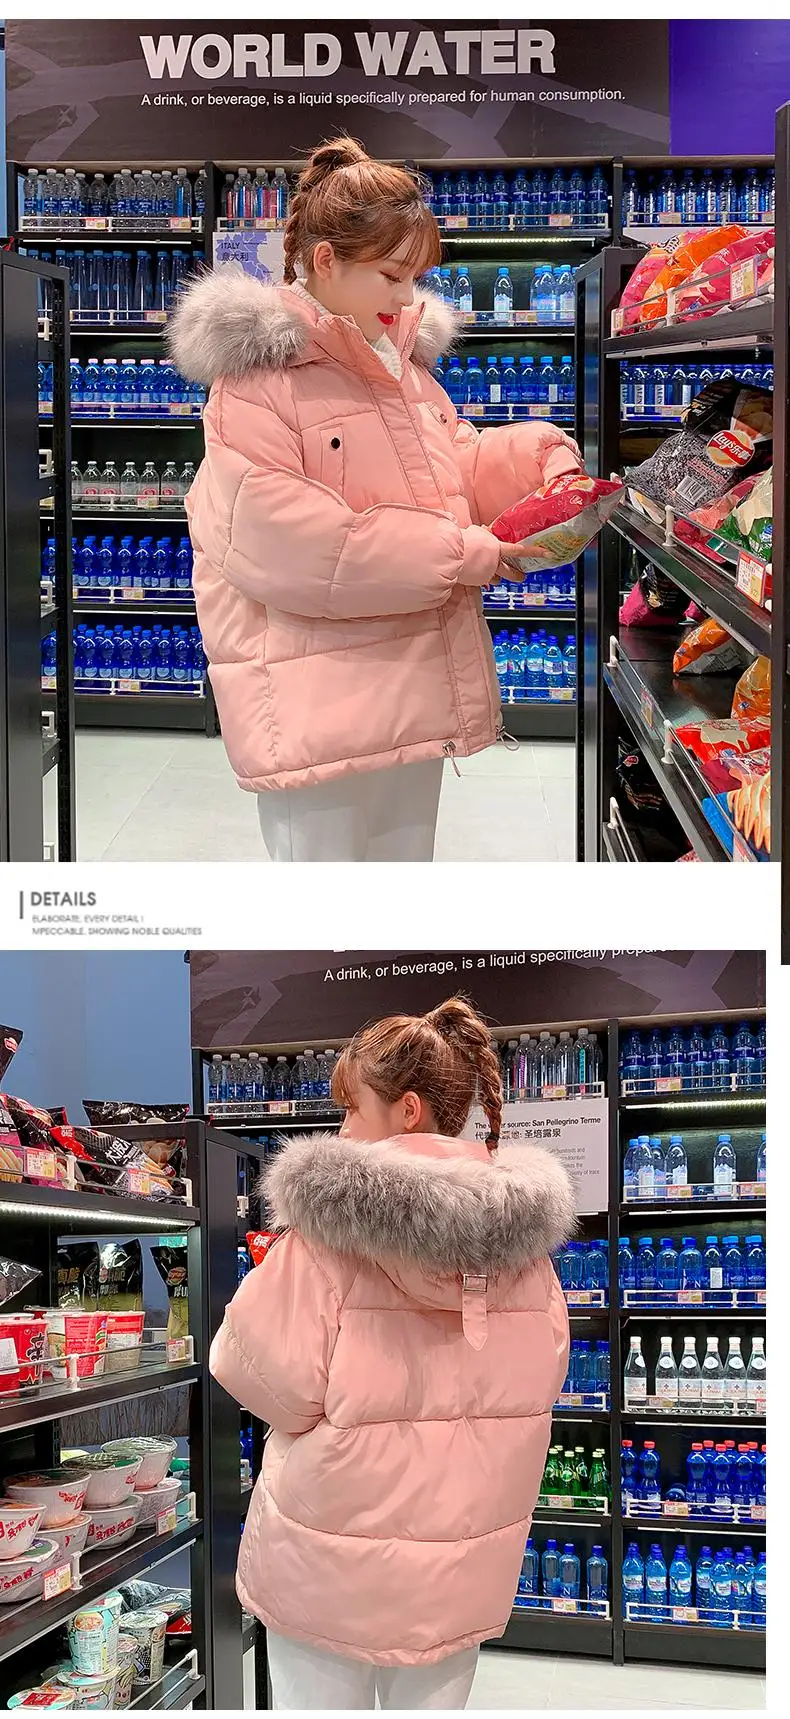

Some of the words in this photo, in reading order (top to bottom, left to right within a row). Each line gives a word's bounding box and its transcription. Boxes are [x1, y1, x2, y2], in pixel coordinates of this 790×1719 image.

[139, 33, 342, 79] WORLD
[354, 29, 556, 76] WATER
[141, 94, 151, 106] A
[154, 93, 188, 107] drink,
[191, 95, 204, 105] or
[208, 93, 270, 107] beverage,
[274, 92, 284, 104] is
[287, 95, 295, 104] a
[299, 92, 332, 106] liquid
[336, 91, 404, 106] specifically
[408, 90, 466, 105] prepared
[469, 89, 487, 102] for
[490, 89, 534, 101] human
[538, 88, 626, 105] consumption.
[221, 242, 240, 250] ITALY
[222, 252, 249, 261] 意大利
[713, 432, 737, 450] Lay's
[324, 968, 334, 981] A
[337, 966, 371, 980] drink,
[375, 966, 389, 977] or
[392, 959, 458, 976] beverage,
[461, 957, 473, 969] is
[477, 958, 486, 968] a
[490, 953, 526, 969] liquid
[530, 950, 608, 966] specifically
[506, 1121, 531, 1129] source:
[532, 1119, 545, 1127] San
[546, 1118, 579, 1127] Pellegrino
[580, 1116, 601, 1125] Terme
[524, 1128, 561, 1139] 圣培露泉
